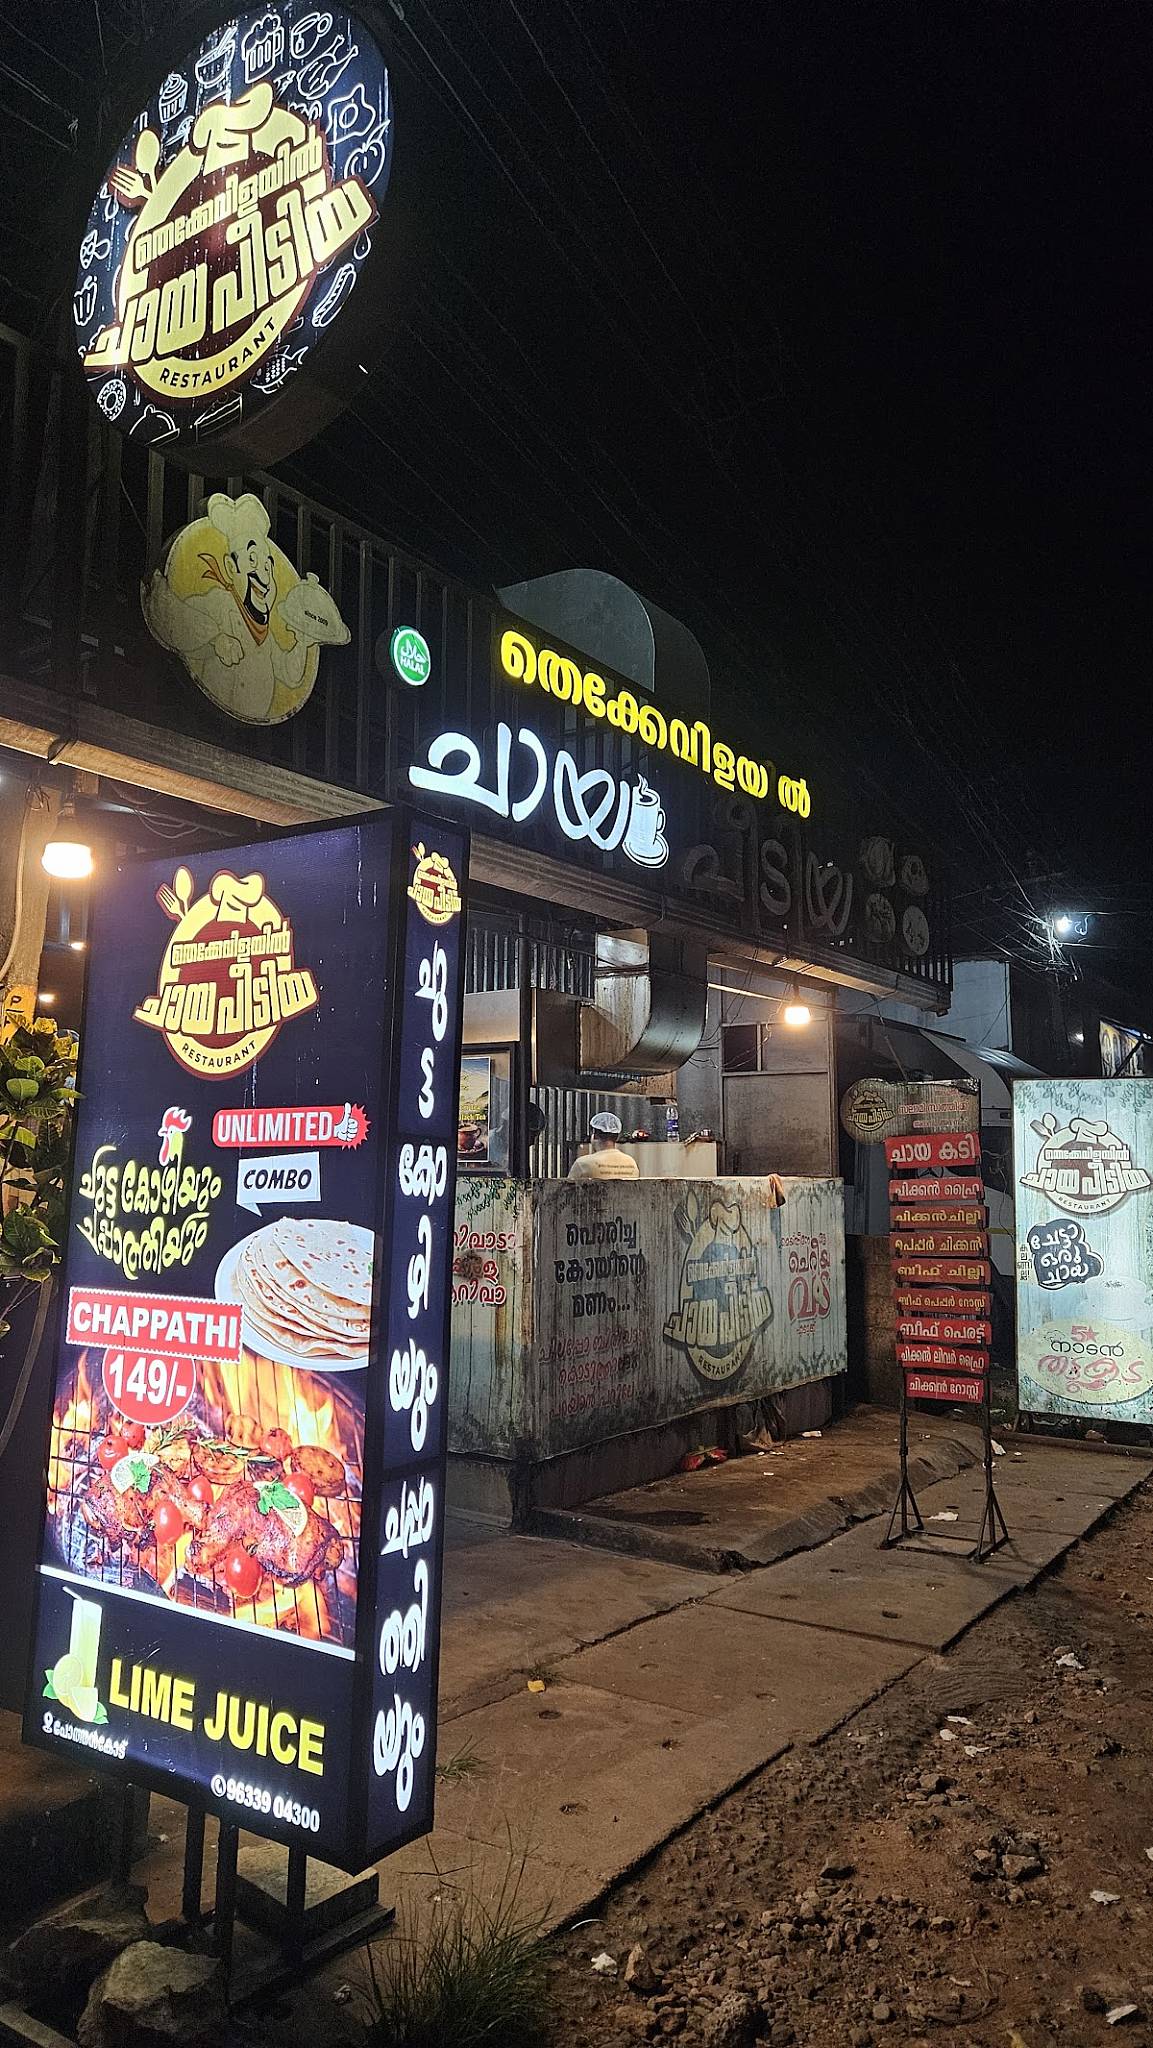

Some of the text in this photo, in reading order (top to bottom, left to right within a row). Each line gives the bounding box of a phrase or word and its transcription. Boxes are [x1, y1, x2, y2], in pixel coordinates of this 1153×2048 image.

[84, 264, 208, 368] ചായ
[160, 320, 276, 388] RESTAURANT
[400, 655, 425, 677] HALAL
[408, 722, 631, 852] ചായ
[134, 982, 216, 1034] ചായ
[182, 1039, 256, 1068] RESTAURANT
[217, 1112, 333, 1144] UNLIMITED
[890, 1134, 976, 1162] ചായ കടി
[243, 1168, 312, 1191] COMBO
[1020, 1168, 1080, 1195] ചായ
[1058, 1197, 1111, 1210] RESTAURANT
[1042, 1263, 1089, 1284] ചായ
[73, 1300, 239, 1350] CHAPPATHI
[664, 1298, 718, 1347] ചായ
[698, 1350, 744, 1375] RESTAURANT
[1050, 1341, 1124, 1357] നാടൻ
[108, 1354, 188, 1408] 149/-
[108, 1658, 326, 1777] LIME JUICE
[226, 1778, 321, 1834] 96339 04300
